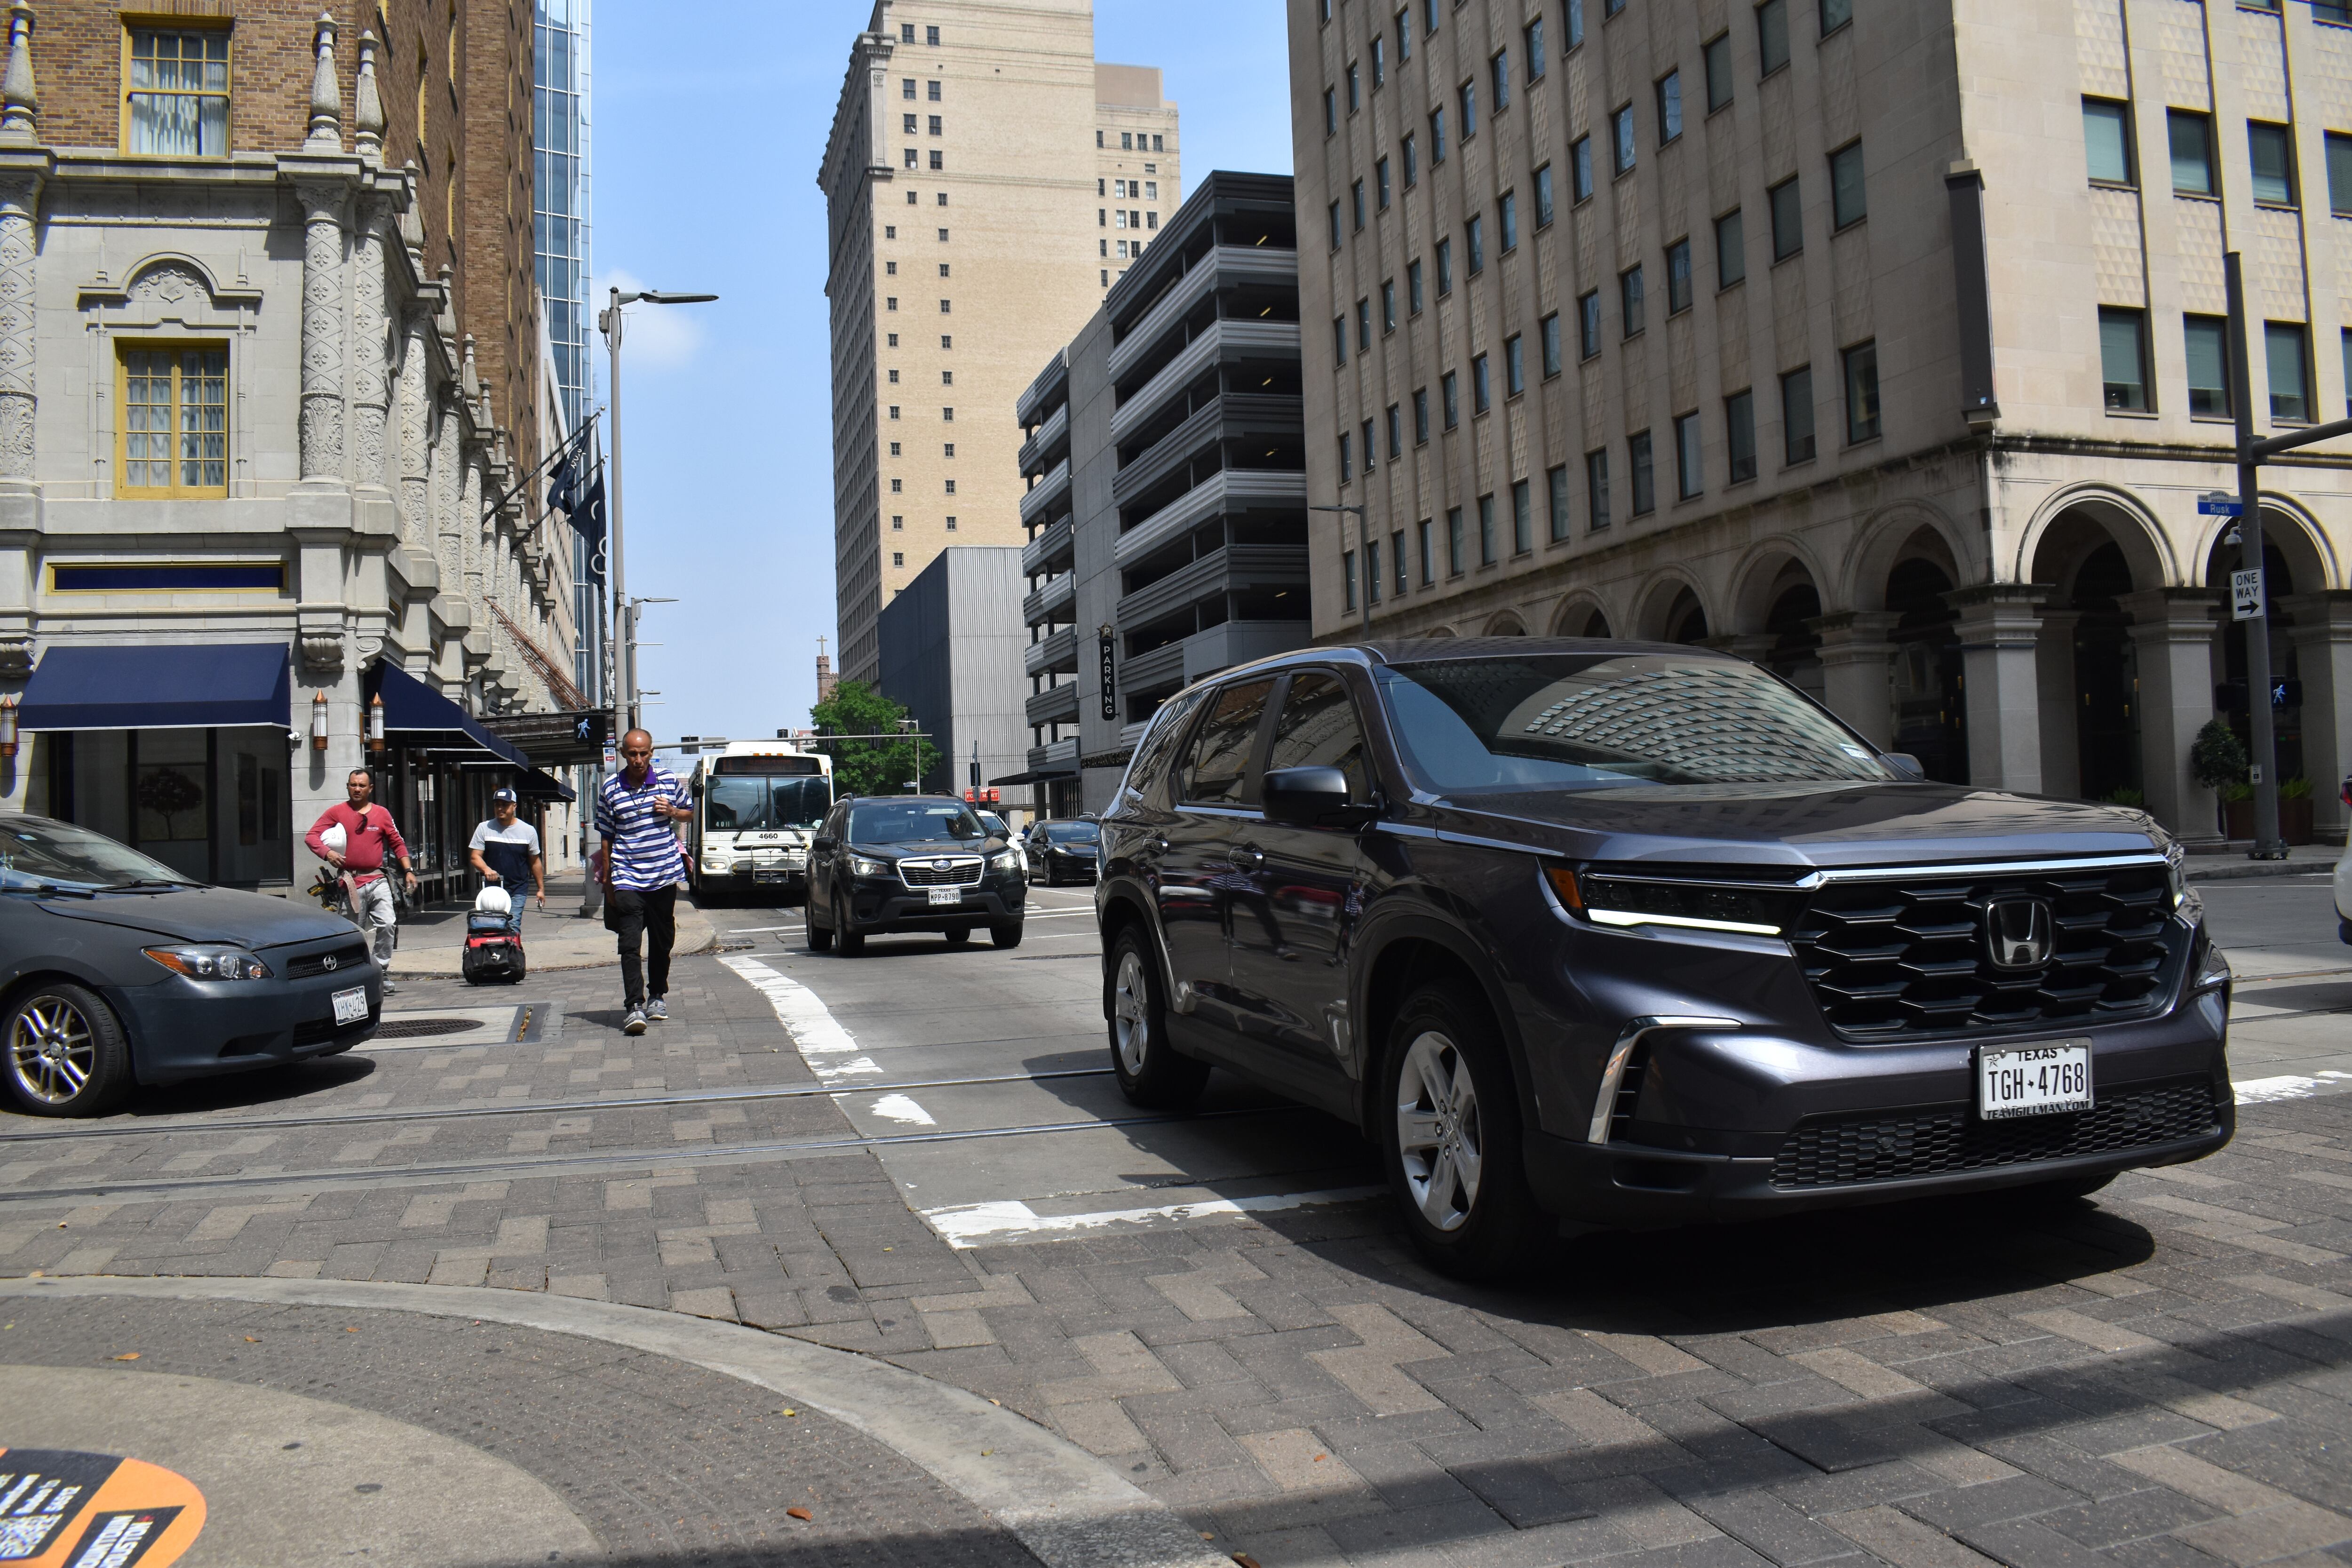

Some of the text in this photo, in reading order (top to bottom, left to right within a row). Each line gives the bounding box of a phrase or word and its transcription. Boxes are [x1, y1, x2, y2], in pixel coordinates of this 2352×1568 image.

[2210, 504, 2230, 514] Rusk
[2236, 572, 2257, 586] ONE
[2236, 585, 2258, 599] WAY
[1103, 645, 1113, 714] PARKING
[1097, 753, 1115, 766] PARKING
[944, 892, 959, 901] 8790
[352, 995, 365, 1013] 429
[2016, 1048, 2058, 1062] TEXAS
[1988, 1062, 2084, 1102] TGH 4768
[1986, 1100, 2090, 1120] TEAMGILLMAN.COM
[72, 1515, 135, 1568] OWNTOWN
